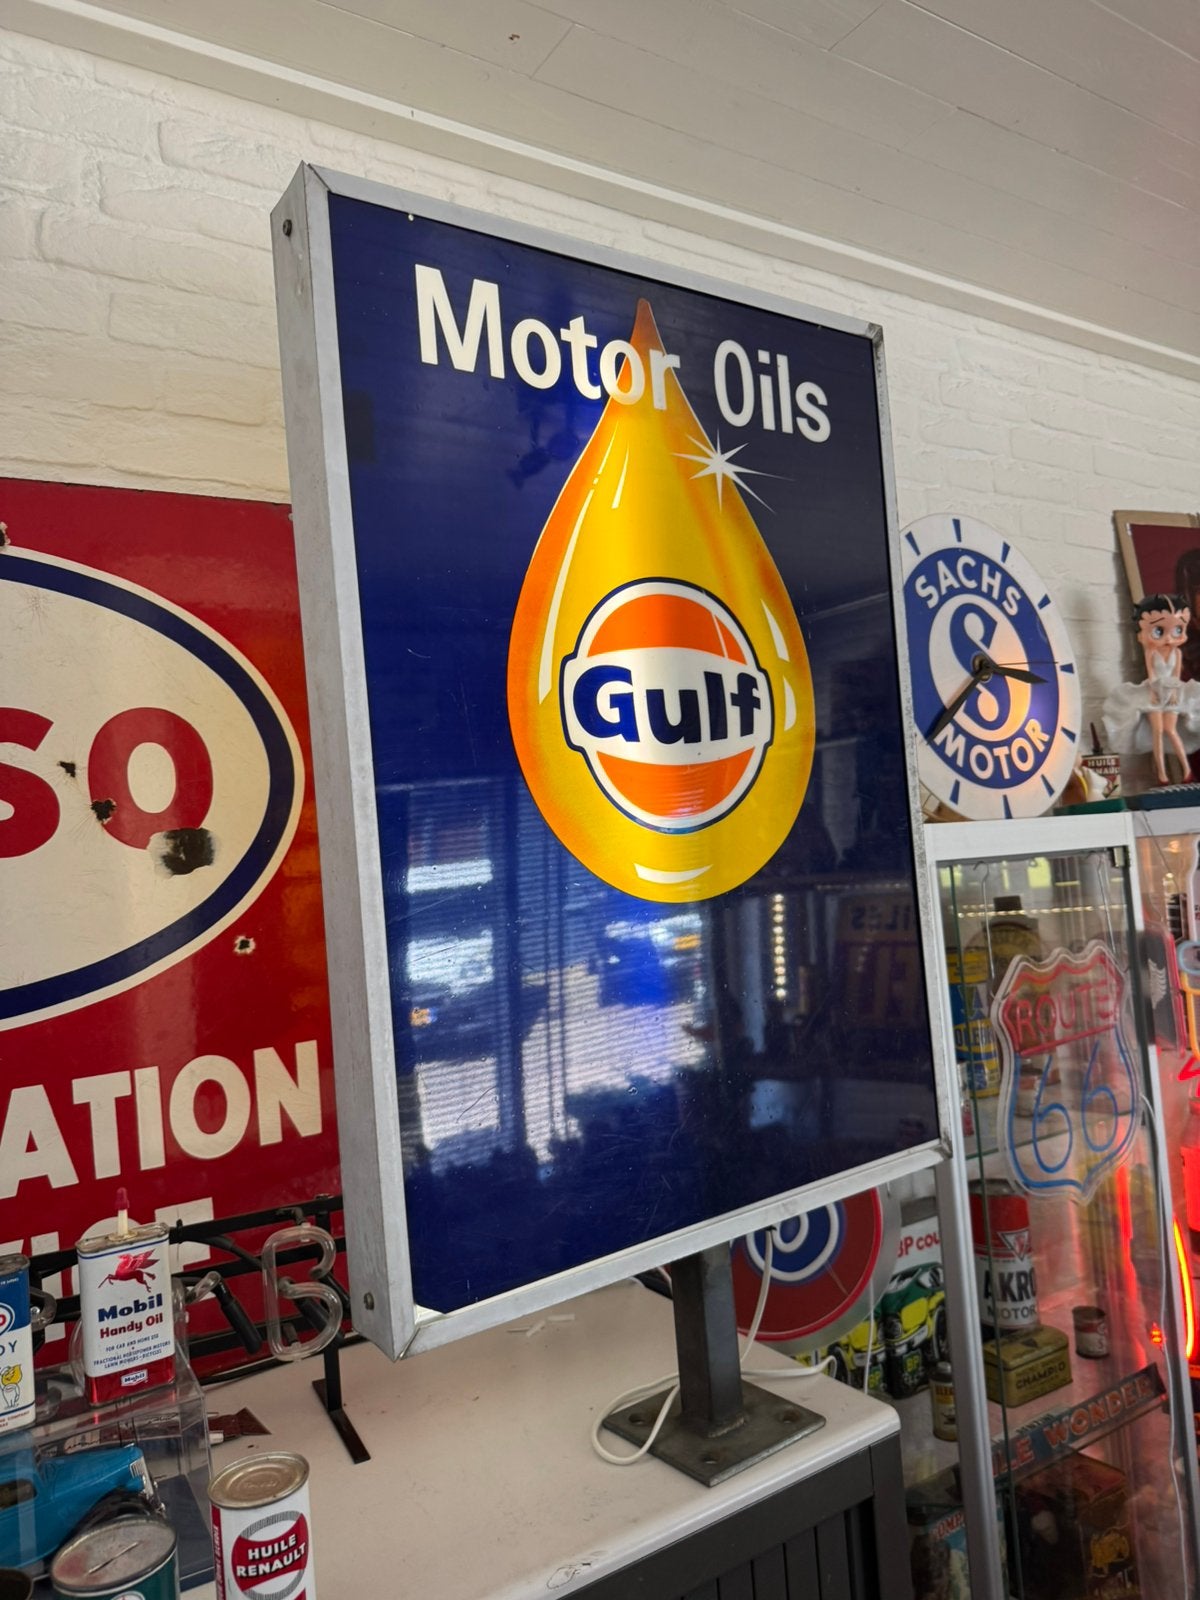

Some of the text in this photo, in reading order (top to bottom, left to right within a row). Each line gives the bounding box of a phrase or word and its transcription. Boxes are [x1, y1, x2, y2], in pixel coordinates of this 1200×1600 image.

[415, 264, 831, 444] Motor Oils
[914, 555, 1022, 617] SACHS
[572, 664, 762, 745] Gulf
[934, 718, 1050, 780] MOTOR
[1014, 979, 1117, 1042] ROUTE
[0, 1040, 324, 1199] ATION
[1031, 1038, 1119, 1173] 66
[98, 1293, 163, 1322] Mobil
[100, 1312, 164, 1339] Handy Oil
[235, 1541, 306, 1578] RENAULT
[247, 1533, 297, 1561] HUILE
